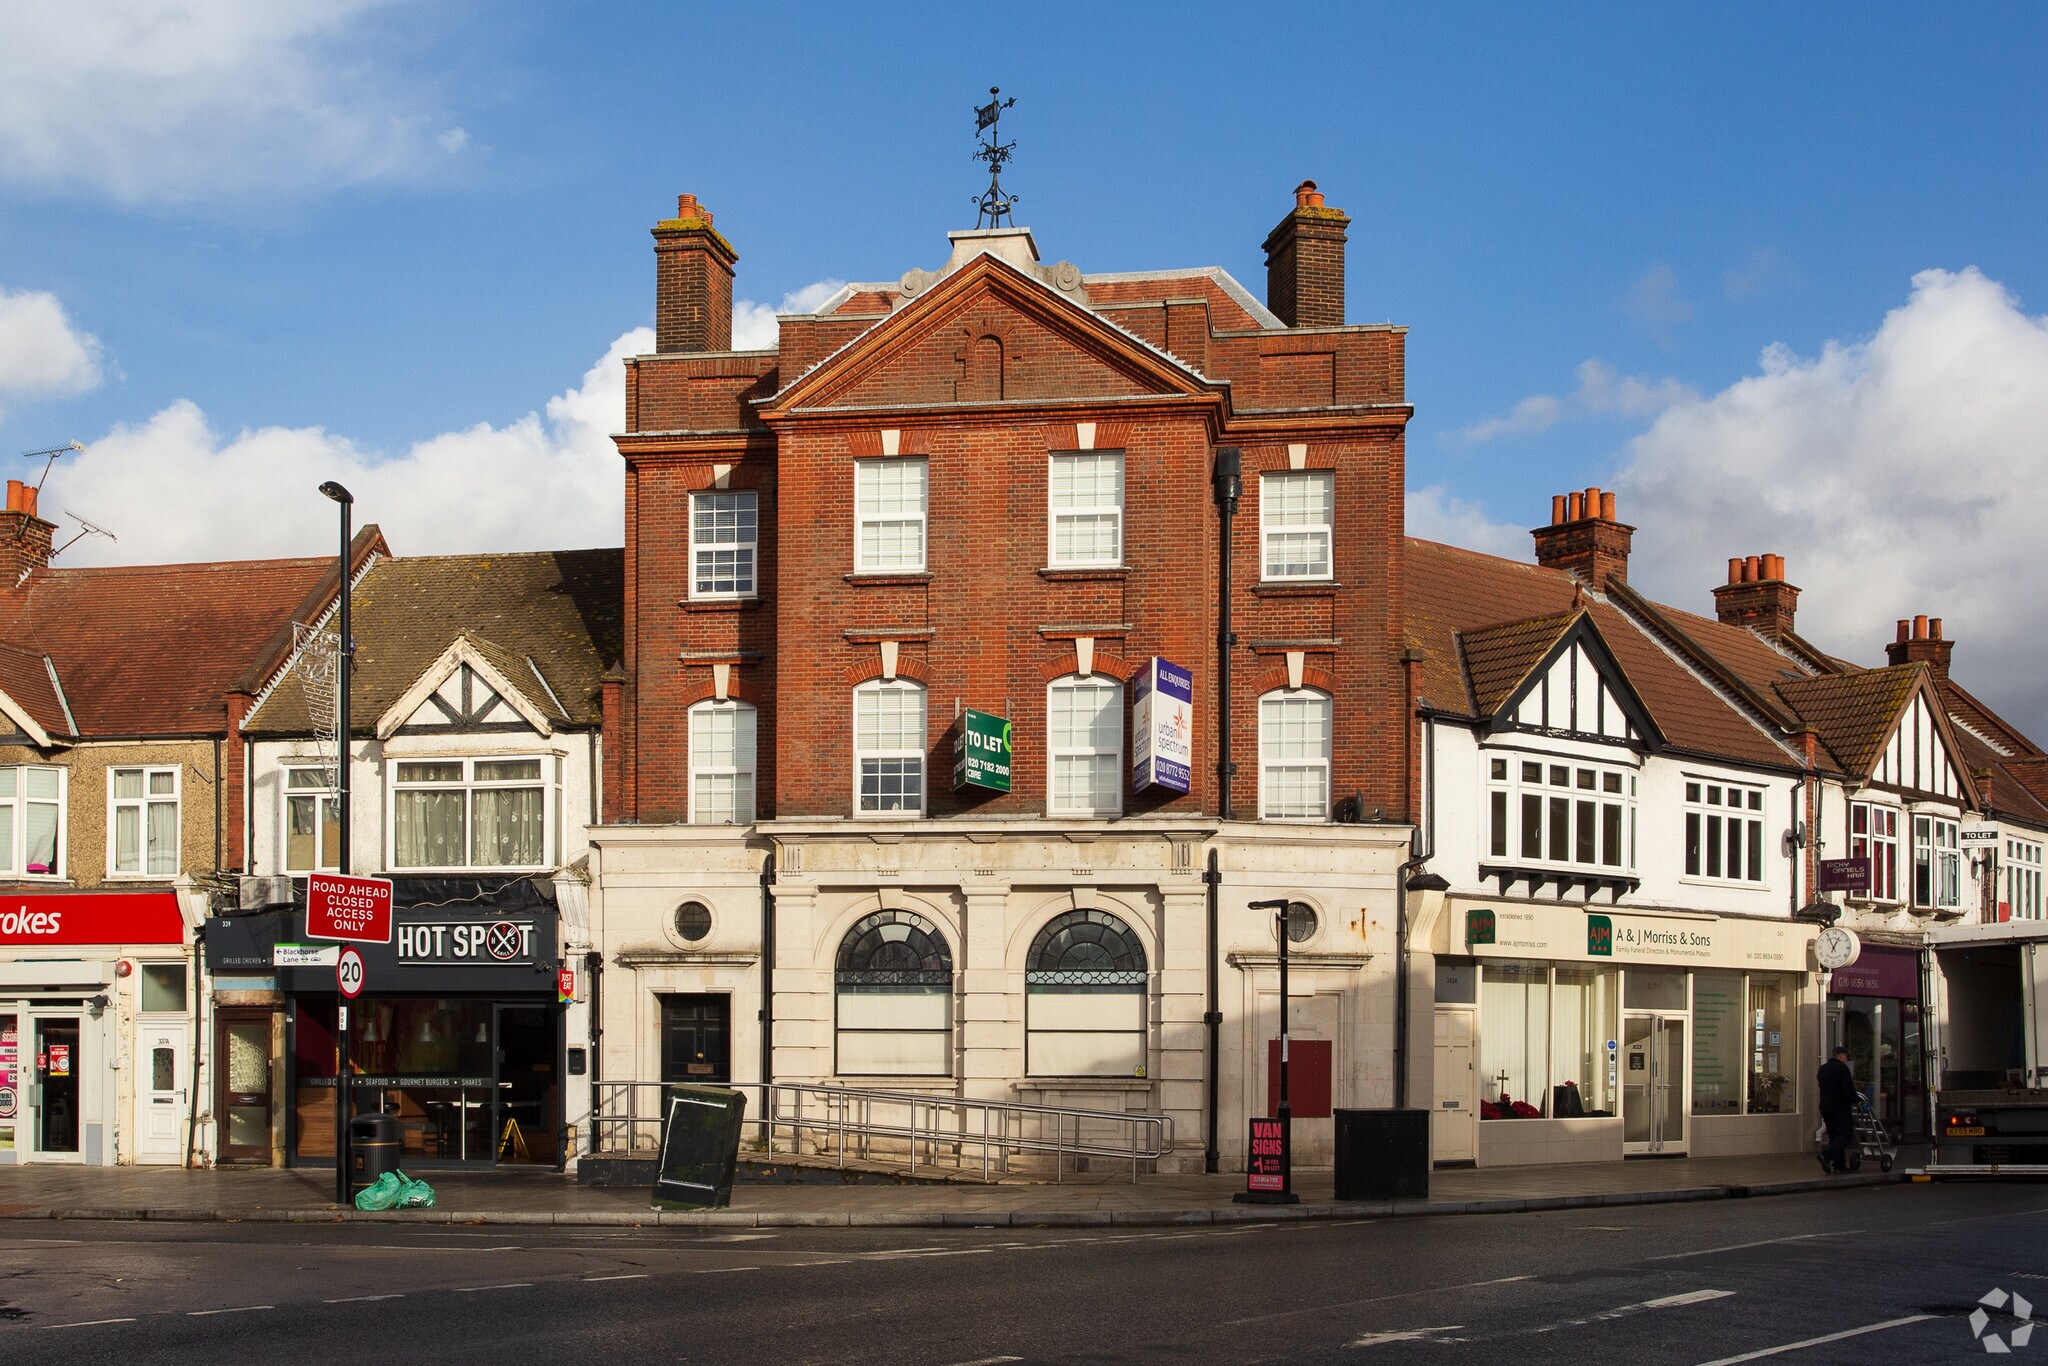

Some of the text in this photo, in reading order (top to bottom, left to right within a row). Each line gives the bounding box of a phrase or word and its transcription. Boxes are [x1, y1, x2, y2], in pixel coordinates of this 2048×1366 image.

[1168, 672, 1190, 690] ENQUIRIES
[1158, 720, 1177, 739] urban
[967, 729, 981, 748] TO
[983, 734, 1002, 753] LET
[1158, 736, 1188, 757] spectrum
[967, 757, 979, 769] 020
[980, 760, 994, 773] 7182
[995, 764, 1010, 777] 2000
[967, 769, 982, 780] CBRE
[1833, 866, 1865, 874] DANIELS
[312, 881, 388, 898] ROAD AHEAD
[327, 895, 374, 908] CLOSED
[327, 907, 374, 920] ACCESS
[334, 919, 365, 932] ONLY
[1471, 916, 1494, 933] AJM
[398, 925, 446, 957] HOT
[1590, 927, 1610, 943] AJM
[1616, 928, 1711, 947] A & J Morriss & Sons
[1499, 940, 1548, 948] www.ajmorriss.com
[1616, 945, 1629, 954] Family
[1631, 946, 1645, 954] Funeral
[1646, 947, 1665, 955] Directors
[341, 961, 361, 983] 20
[561, 973, 572, 983] JUST
[563, 982, 572, 990] EAT
[1838, 976, 1849, 987] 020
[366, 1078, 389, 1086] SEAFOOD
[400, 1078, 449, 1086] GOURMET BURGERS
[461, 1078, 482, 1086] SHAKES
[1253, 1122, 1282, 1138] VAN
[1253, 1139, 1282, 1155] SIGNS
